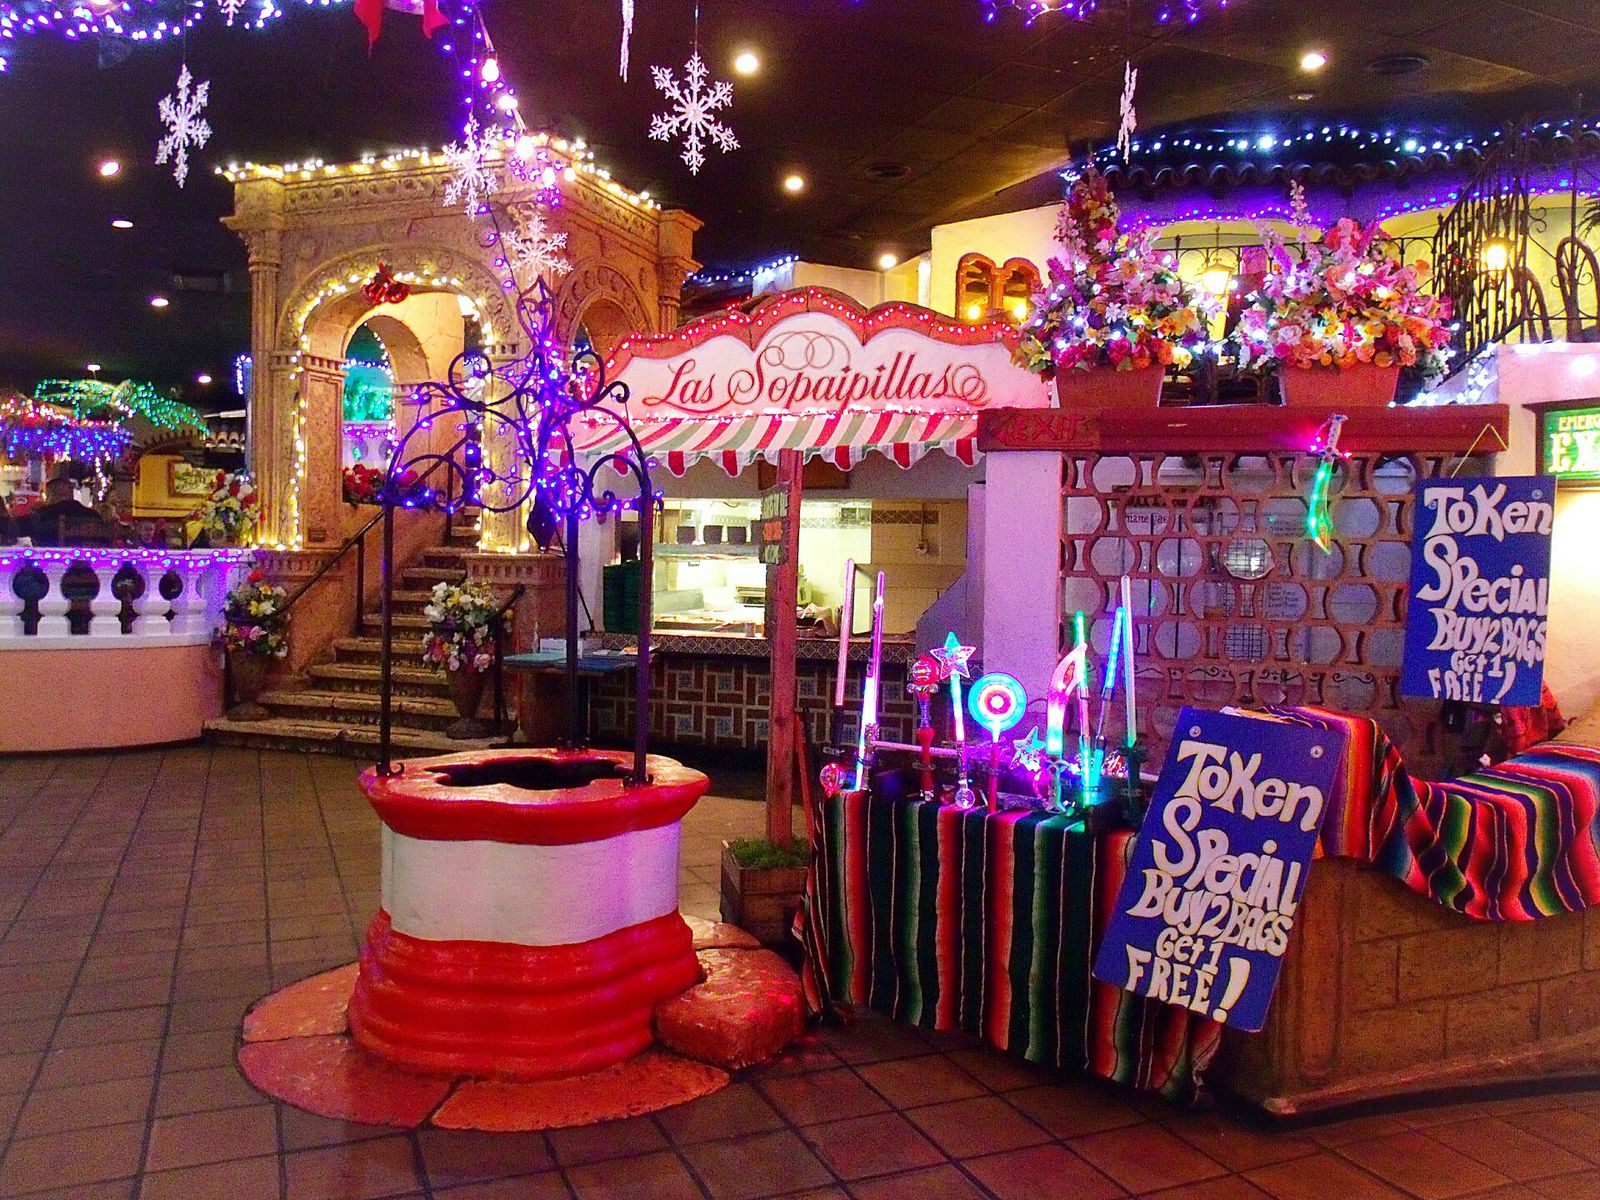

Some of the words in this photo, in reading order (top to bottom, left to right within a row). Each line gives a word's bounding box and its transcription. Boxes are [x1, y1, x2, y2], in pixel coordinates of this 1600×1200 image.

[642, 358, 718, 414] Las
[728, 345, 966, 411] Sopaipillas
[1008, 411, 1088, 441] EXIT
[1451, 651, 1488, 675] Get
[1488, 653, 1503, 677] 1
[1156, 927, 1205, 965] Get
[1202, 942, 1225, 975] 1
